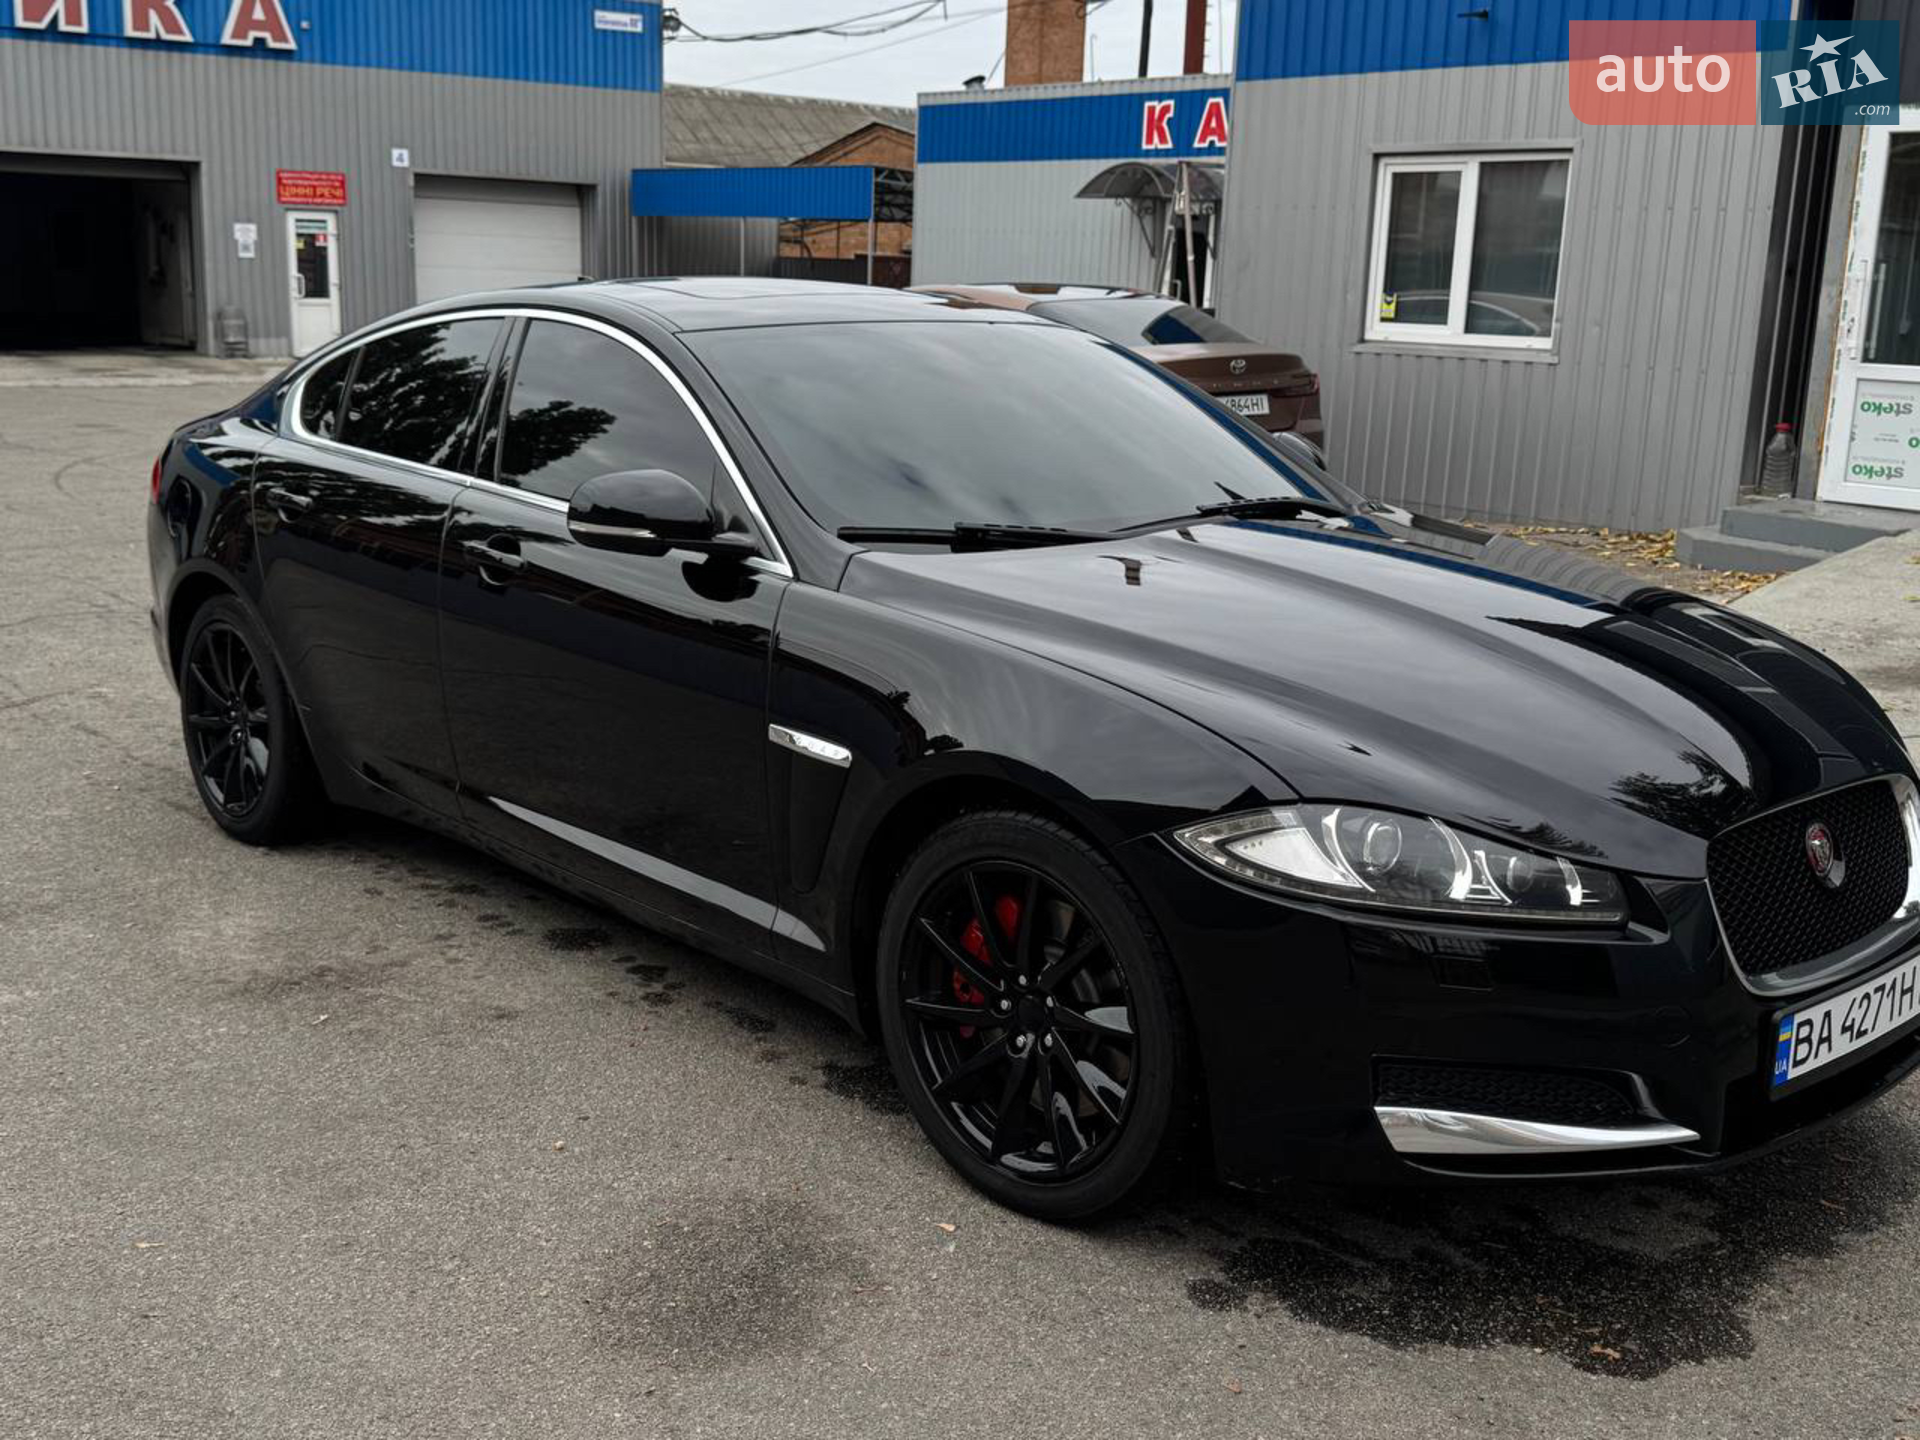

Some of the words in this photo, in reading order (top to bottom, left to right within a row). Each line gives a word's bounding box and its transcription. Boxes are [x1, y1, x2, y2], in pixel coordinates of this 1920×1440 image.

[1860, 400, 1914, 417] steko
[1851, 464, 1905, 480] steko
[1791, 1009, 1832, 1069] BA
[1775, 1060, 1787, 1075] UA
